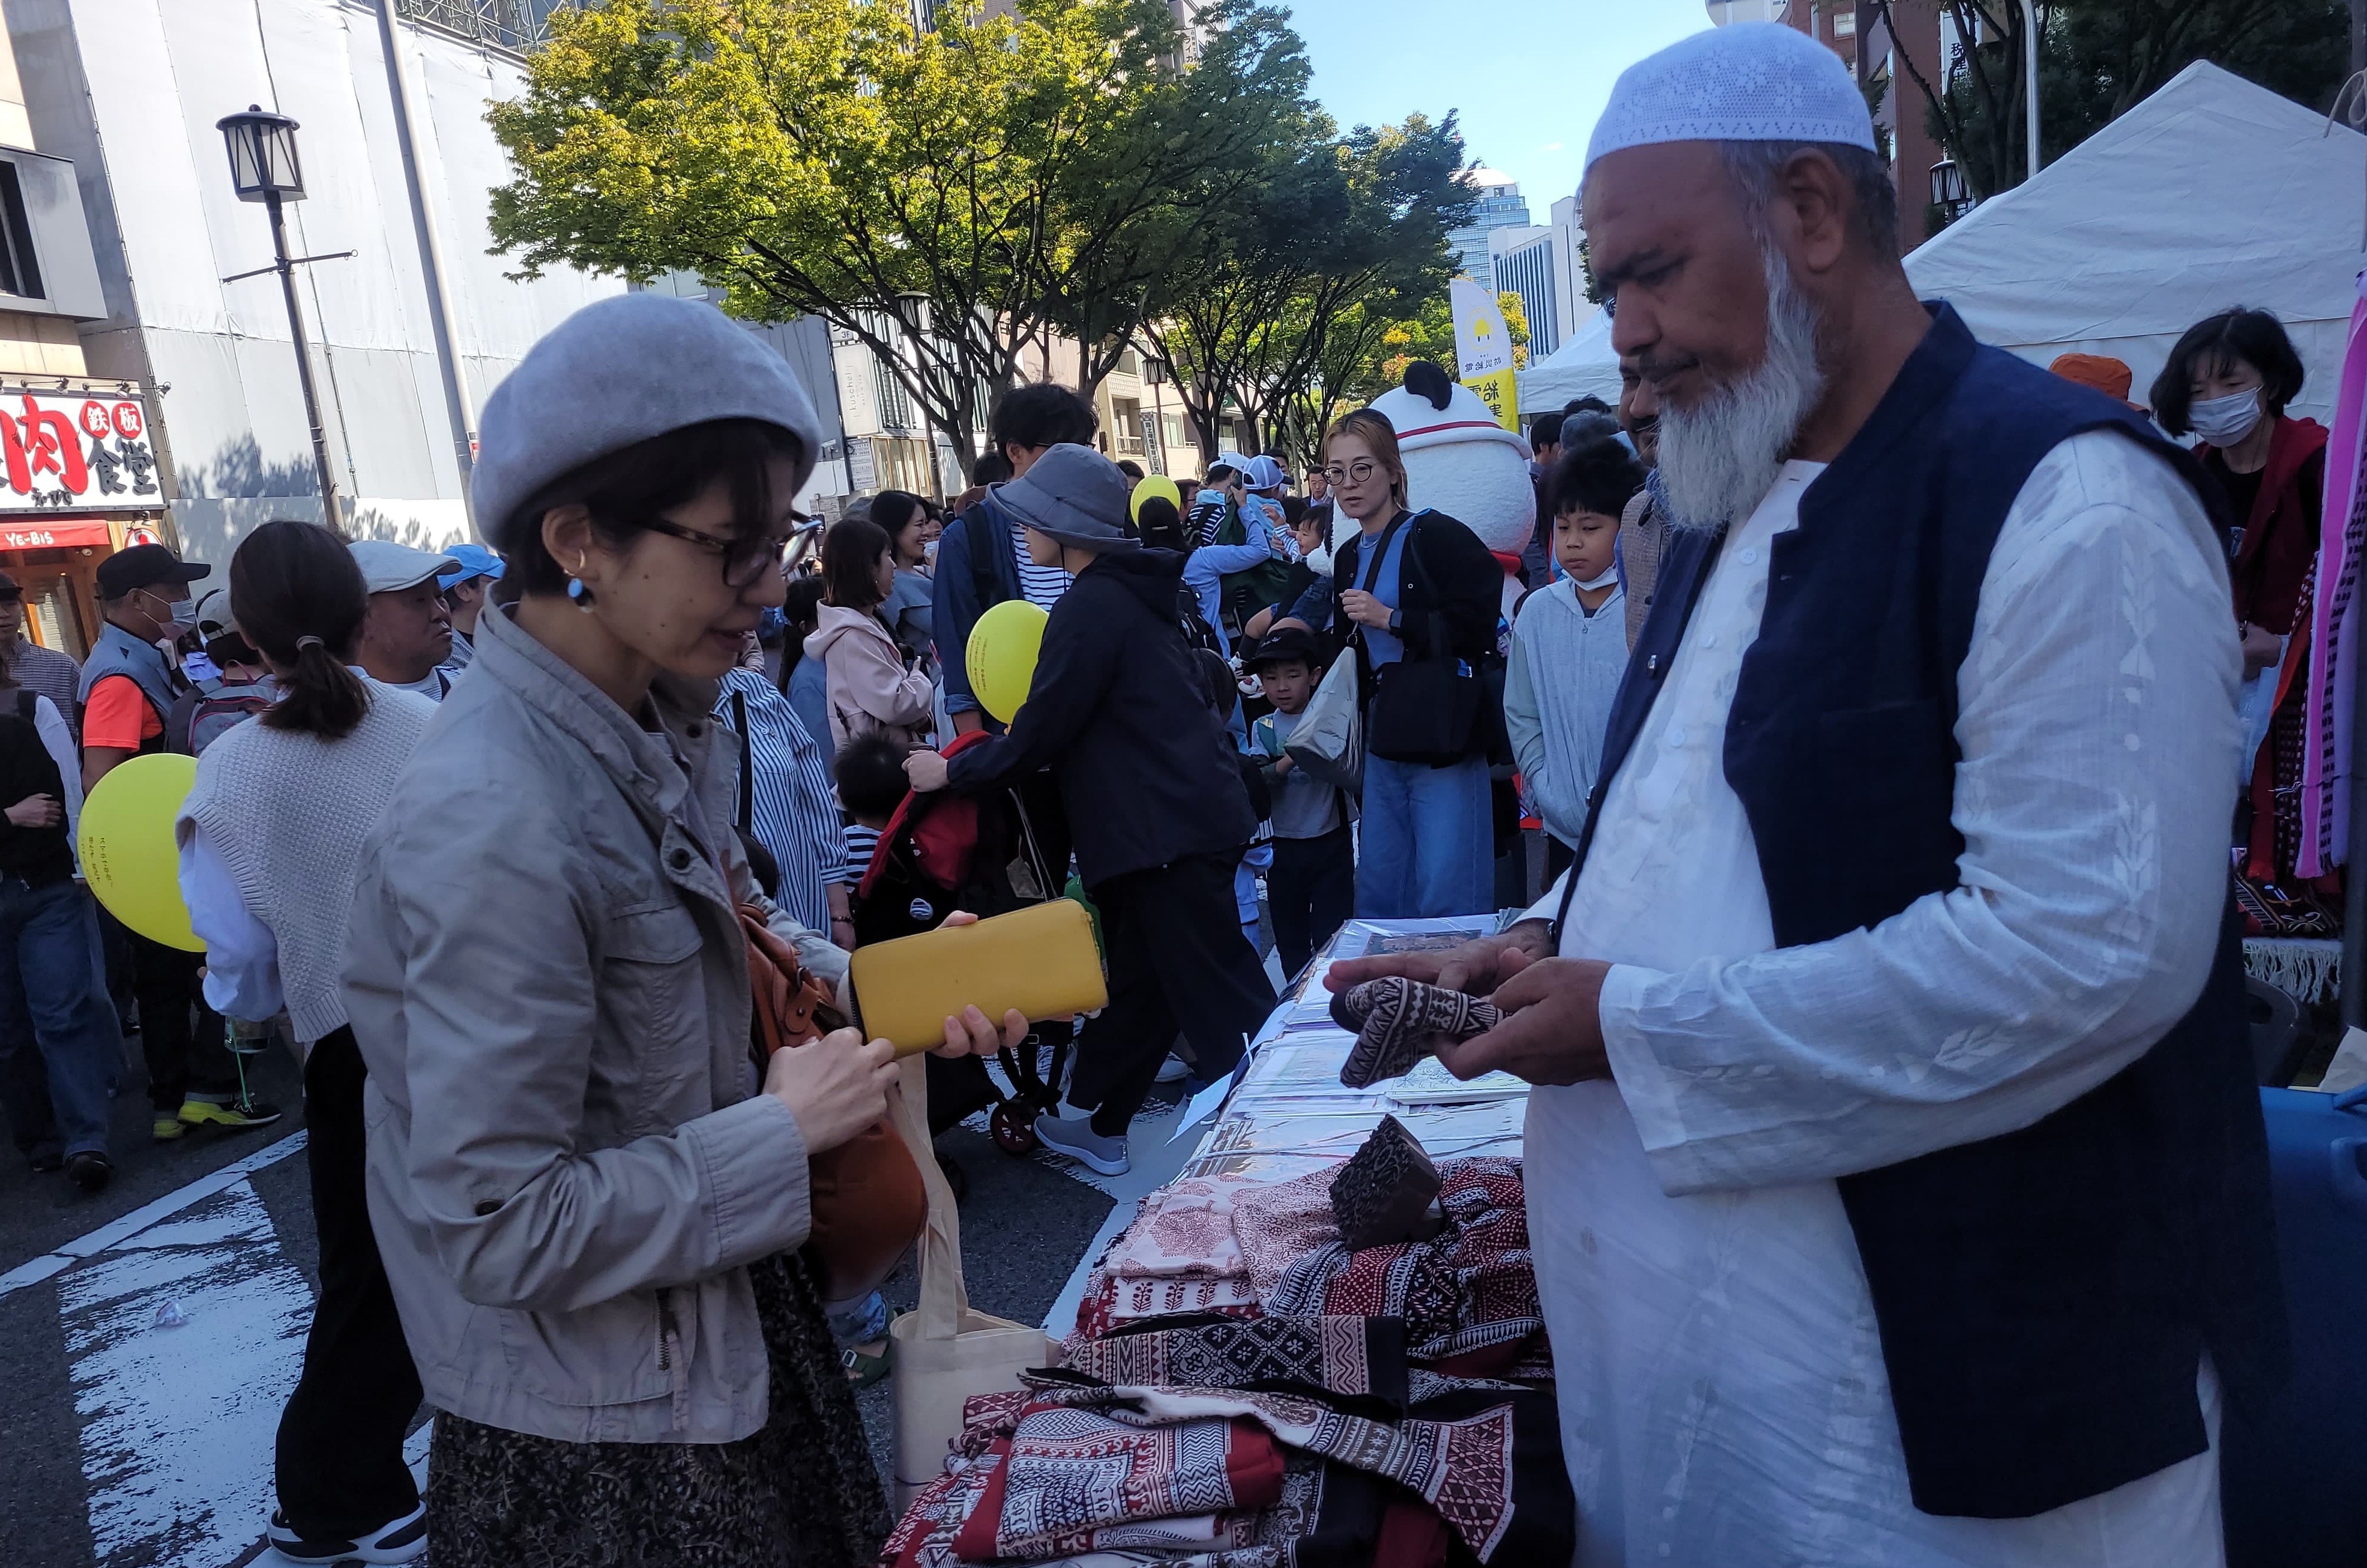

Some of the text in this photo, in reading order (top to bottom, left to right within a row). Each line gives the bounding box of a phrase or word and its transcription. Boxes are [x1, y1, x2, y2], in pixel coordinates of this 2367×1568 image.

[0, 394, 89, 496] 肉
[87, 406, 140, 432] 鉄板
[87, 438, 157, 496] 食堂
